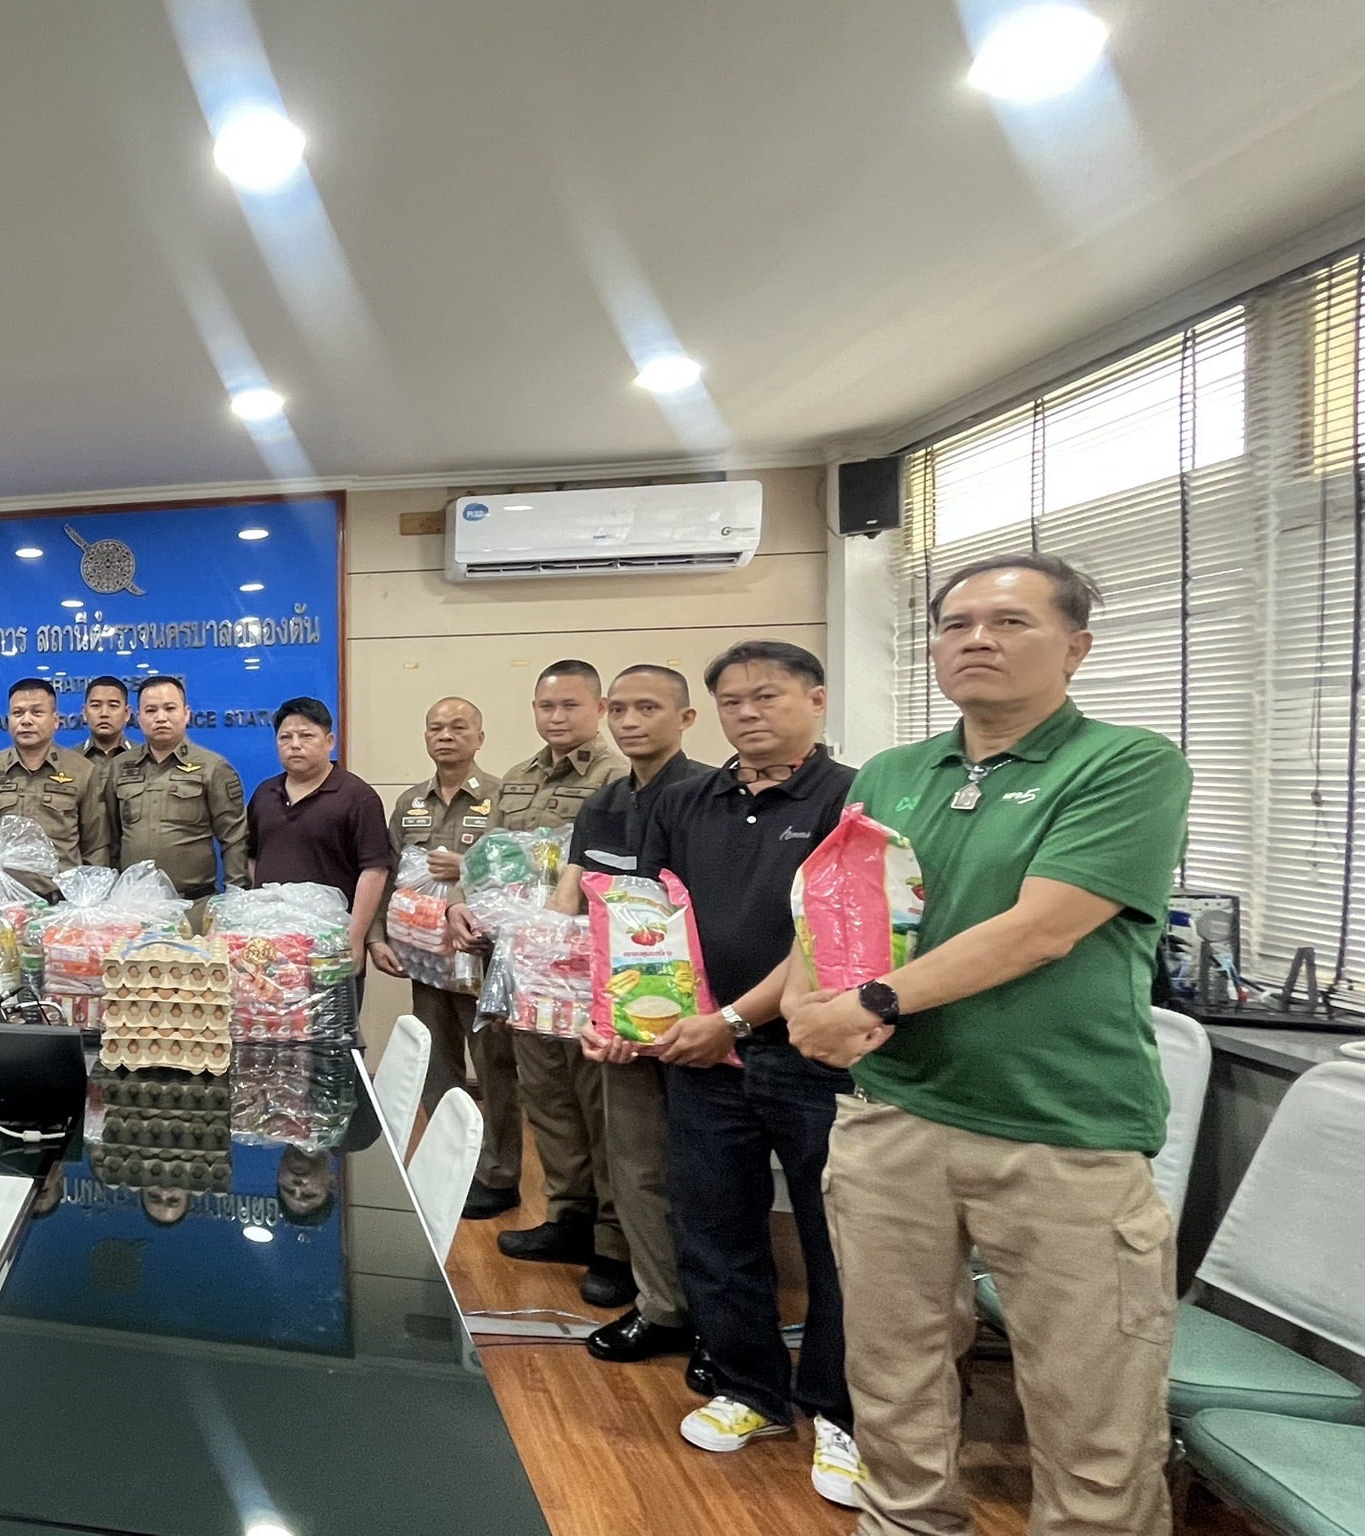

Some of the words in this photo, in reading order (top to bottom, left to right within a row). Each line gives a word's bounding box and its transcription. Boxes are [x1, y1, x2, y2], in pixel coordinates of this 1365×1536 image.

[36, 603, 320, 652] สถานีตำรวจนครบาลคลองตัน
